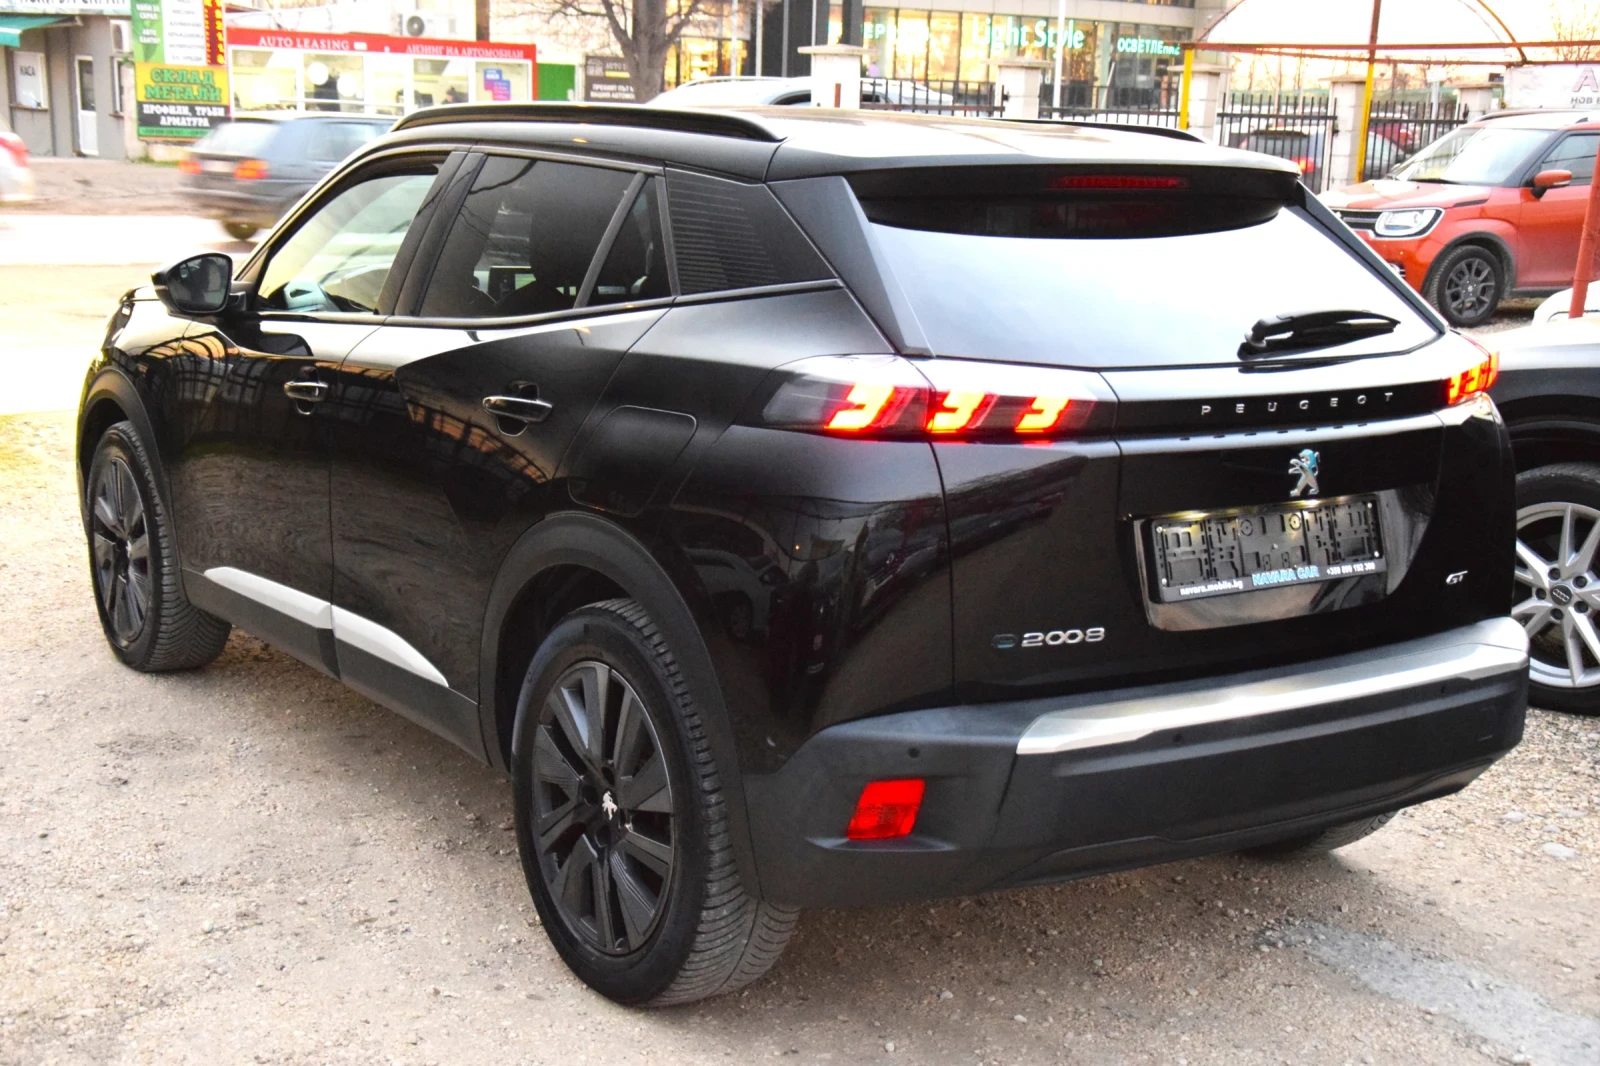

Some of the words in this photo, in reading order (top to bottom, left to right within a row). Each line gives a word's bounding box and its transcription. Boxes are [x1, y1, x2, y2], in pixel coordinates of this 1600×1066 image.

[259, 36, 293, 47] AUTO
[296, 38, 350, 51] LEASING
[972, 16, 1029, 53] Light
[446, 46, 460, 56] НА
[151, 68, 215, 86] СКЛАД
[144, 84, 222, 102] МЕТАЛИ
[160, 116, 210, 127] АРМАТУРА
[1201, 392, 1394, 416] PEUGEOT
[1180, 579, 1243, 596] navara.mobile.bg
[1251, 569, 1297, 586] NAVARA
[1297, 565, 1320, 580] CAR
[1446, 570, 1468, 584] GT
[1021, 626, 1105, 648] 2008
